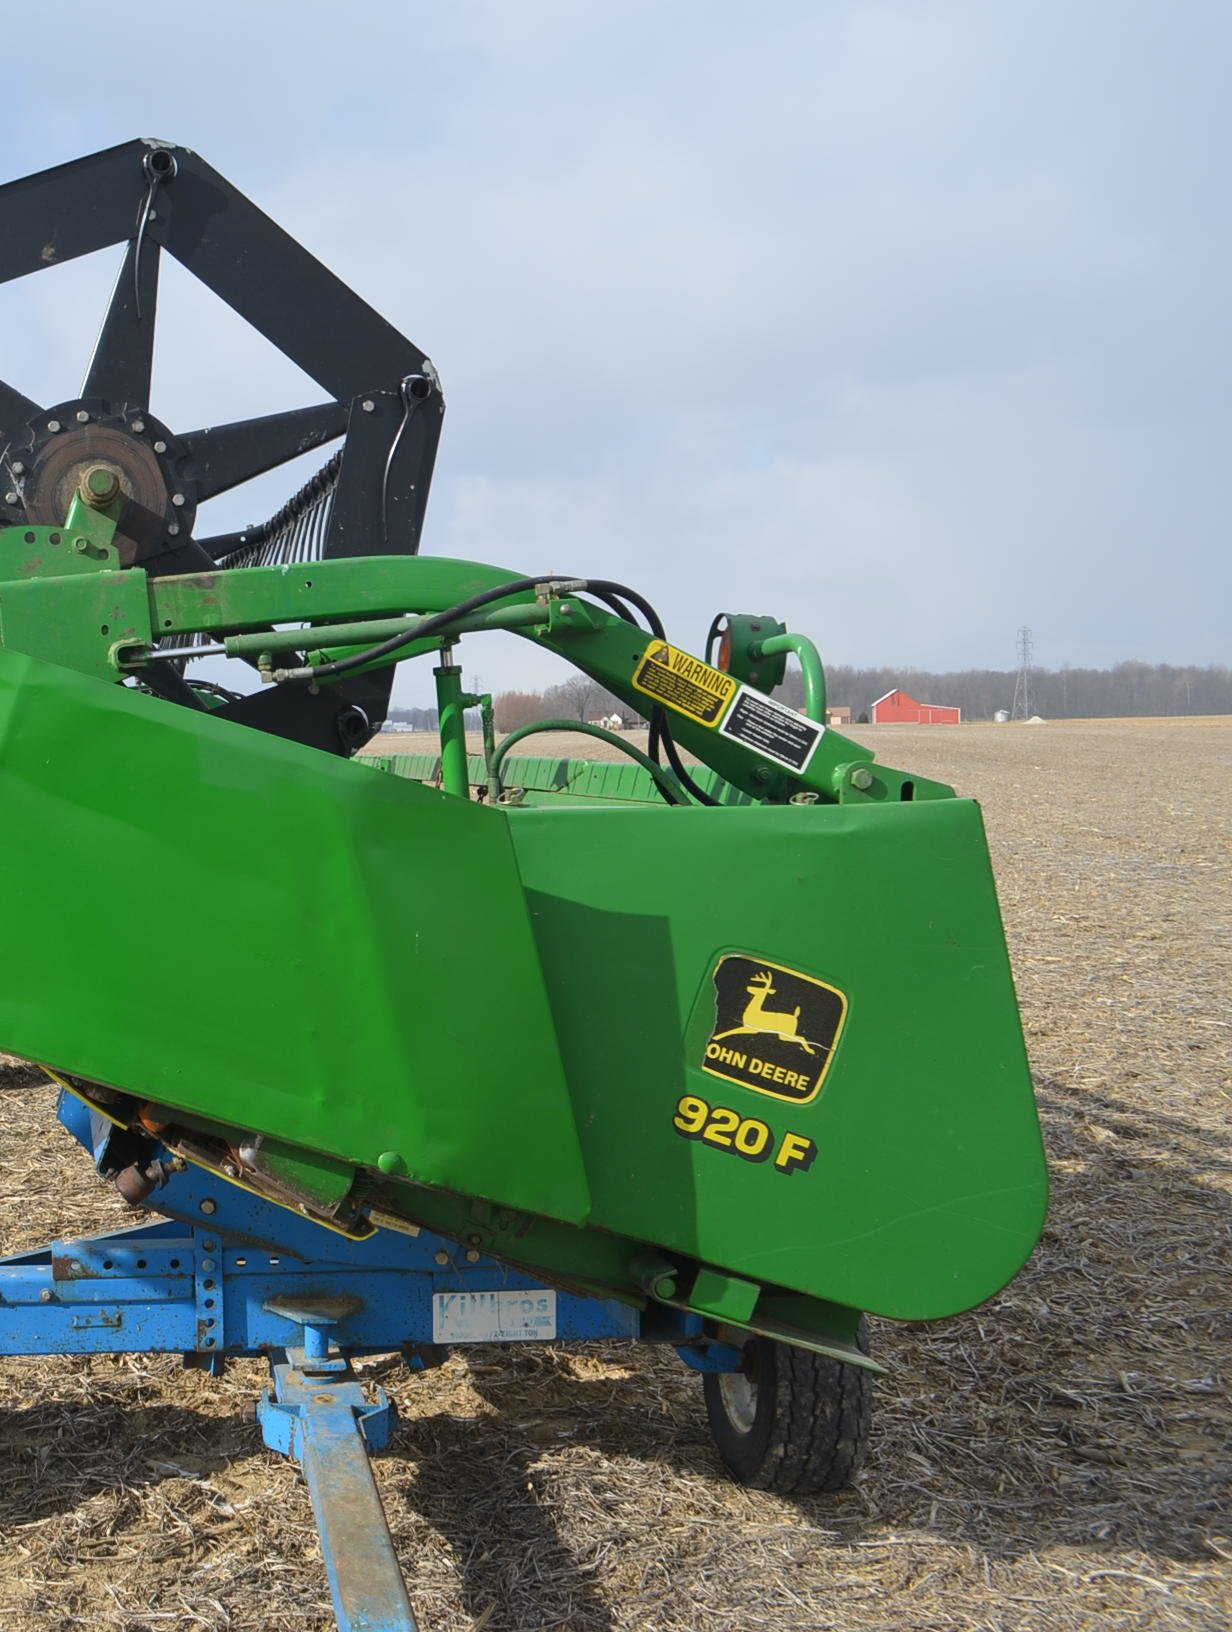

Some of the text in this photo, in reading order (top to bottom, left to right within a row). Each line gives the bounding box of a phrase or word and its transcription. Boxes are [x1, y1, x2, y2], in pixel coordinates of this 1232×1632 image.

[672, 653, 732, 699] WARNING
[705, 1043, 811, 1091] OHN DEERE
[673, 1095, 815, 1172] 920 F
